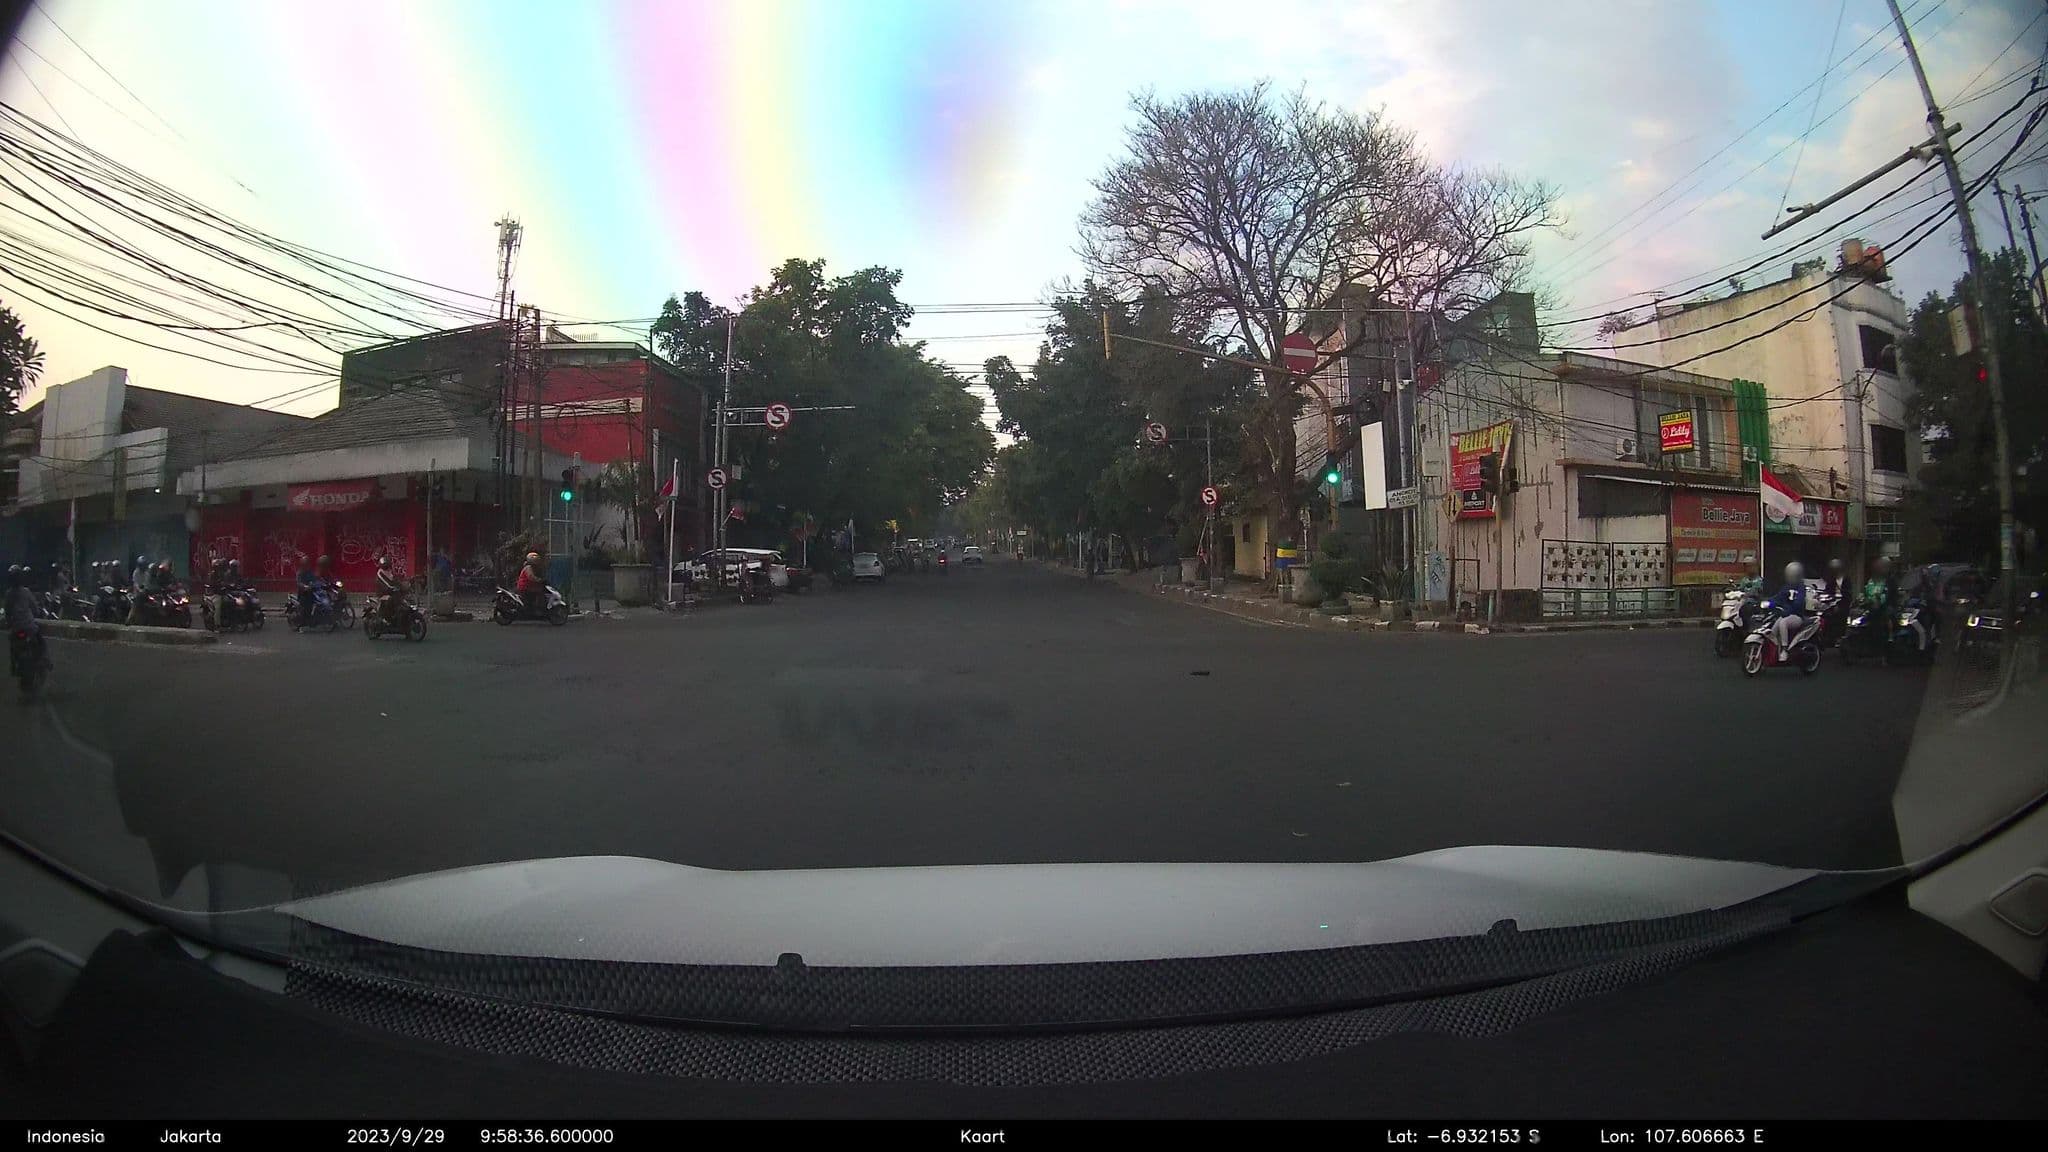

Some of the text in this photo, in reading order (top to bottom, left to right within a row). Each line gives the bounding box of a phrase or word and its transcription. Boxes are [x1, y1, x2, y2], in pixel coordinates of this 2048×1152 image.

[1458, 427, 1488, 452] BELLIE
[1703, 507, 1729, 522] Bellie
[1730, 508, 1751, 525] Jaya
